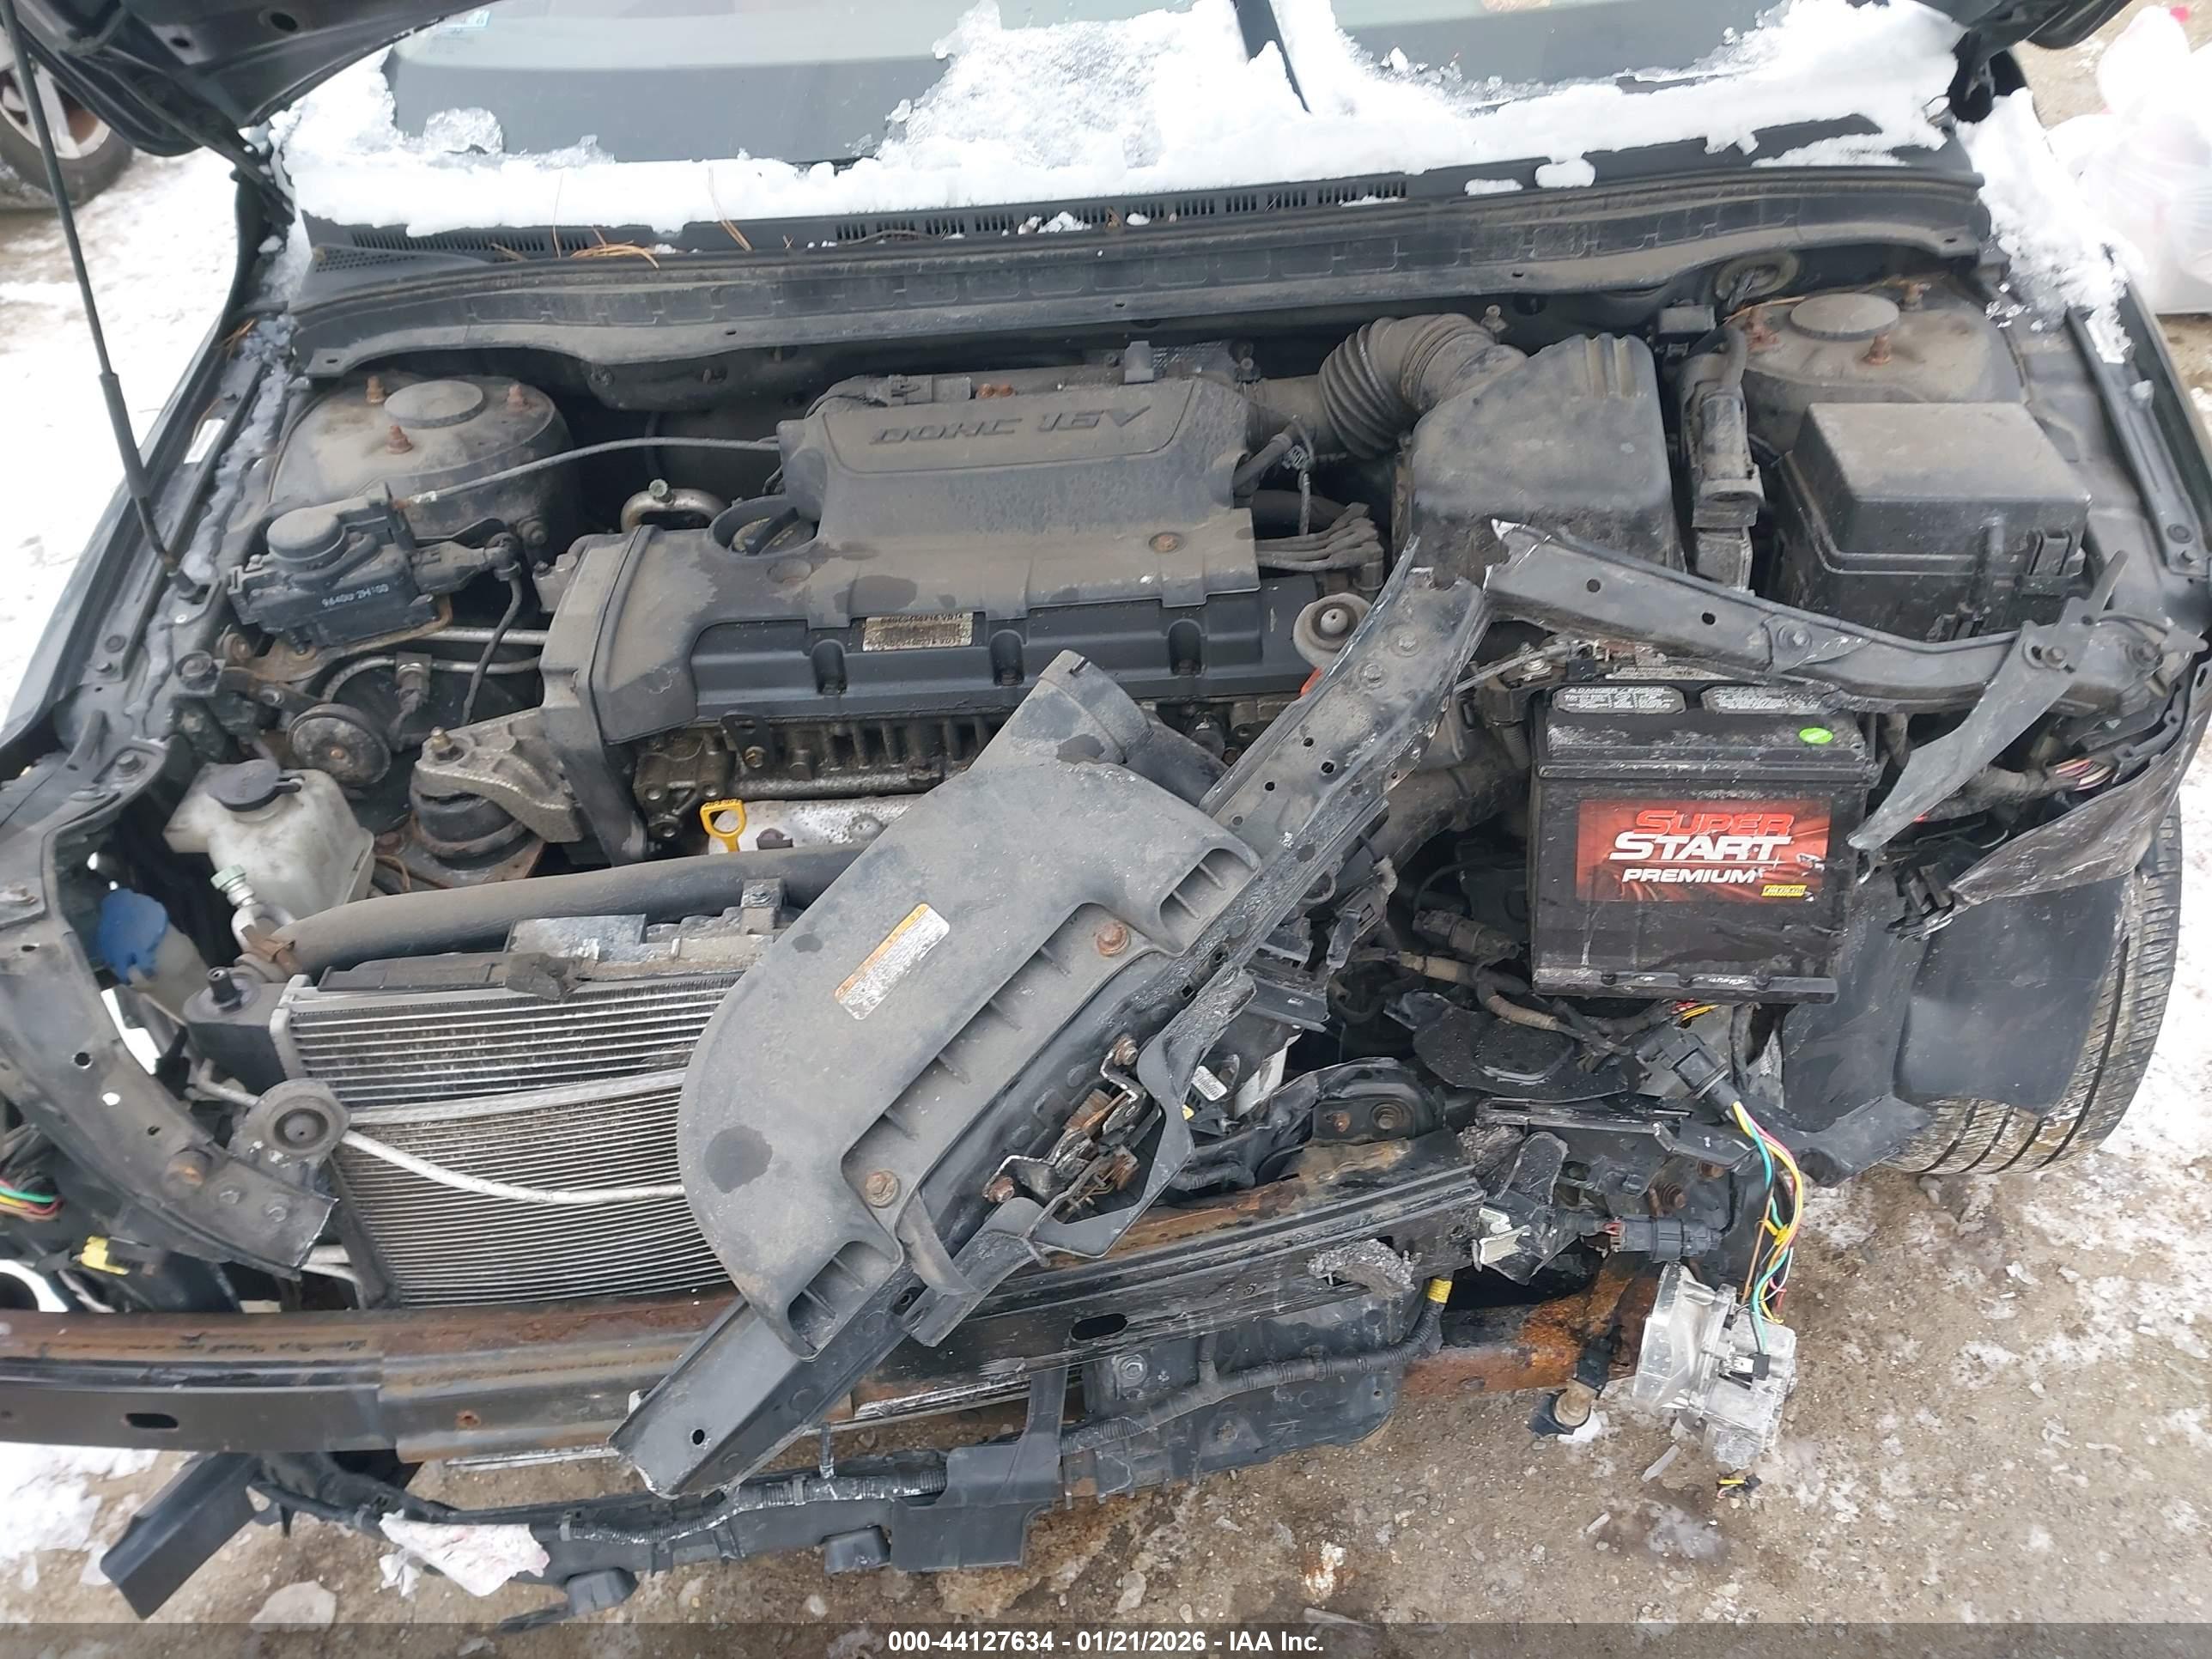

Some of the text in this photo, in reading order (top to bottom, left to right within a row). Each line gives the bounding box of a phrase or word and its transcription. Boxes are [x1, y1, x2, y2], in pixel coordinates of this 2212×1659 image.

[869, 405, 1152, 446] DOHC 16V
[1633, 809, 1795, 836] SUPER
[1608, 830, 1792, 860] START
[1621, 867, 1759, 884] PREMIUM
